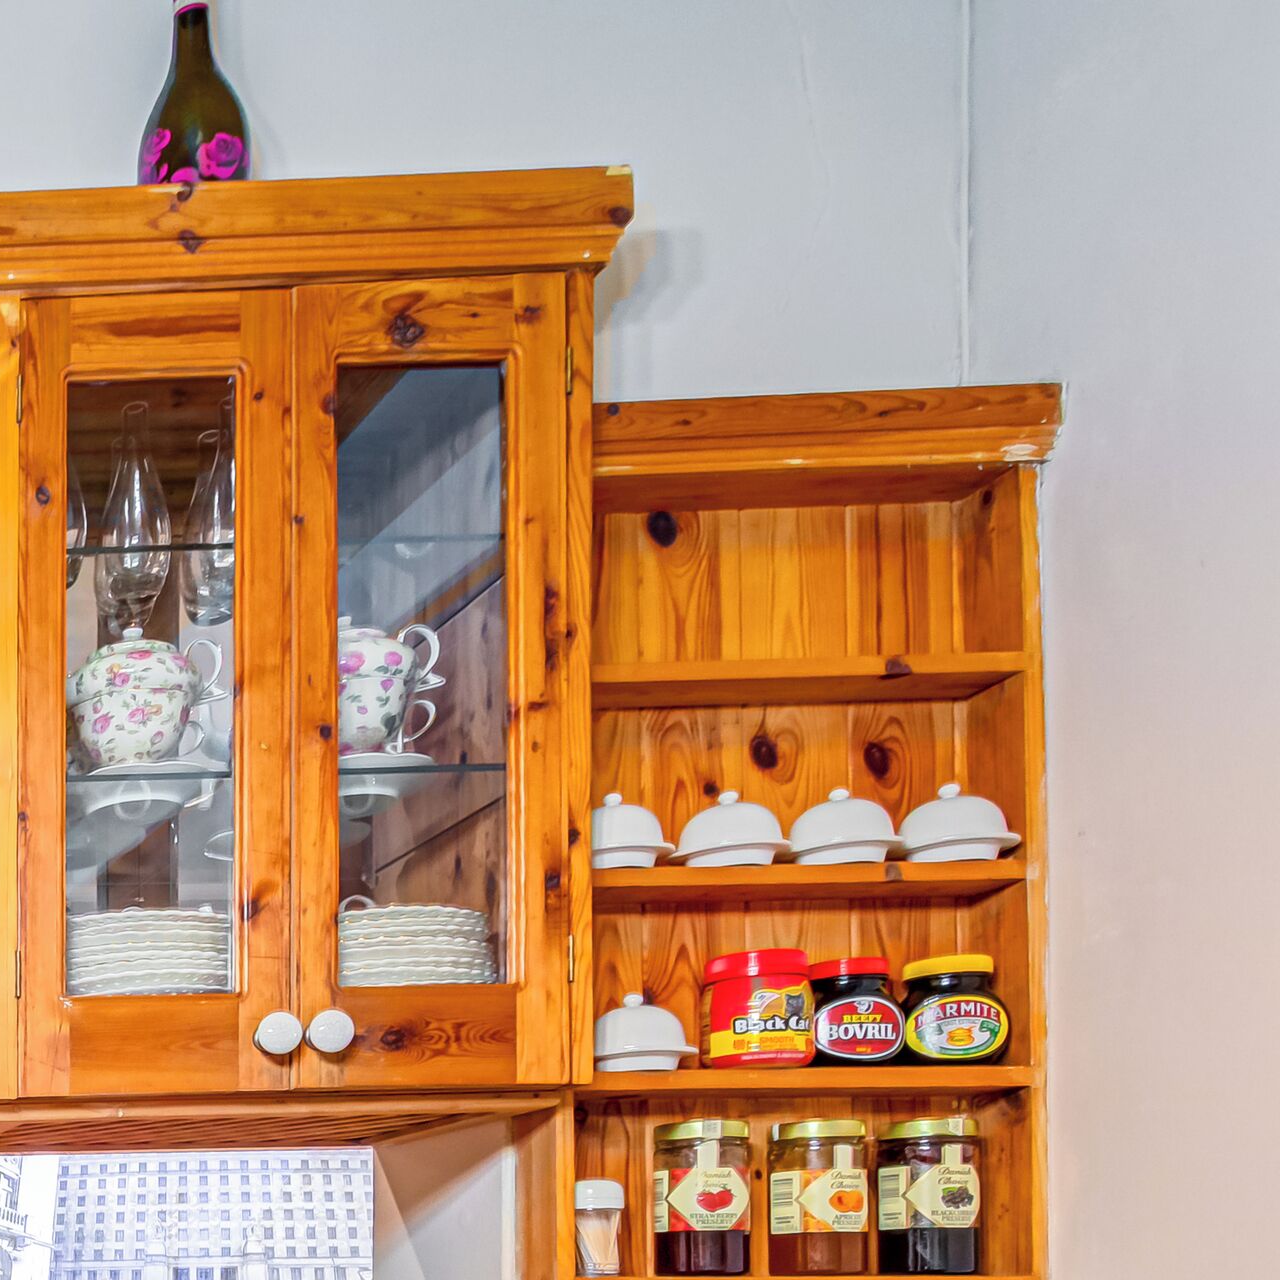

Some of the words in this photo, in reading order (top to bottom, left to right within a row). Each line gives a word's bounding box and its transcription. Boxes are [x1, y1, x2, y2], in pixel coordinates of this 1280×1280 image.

[843, 1014, 882, 1023] BEEFY
[916, 1001, 998, 1028] MARMITE
[734, 1015, 786, 1034] Black
[827, 1023, 896, 1041] BOVRIL
